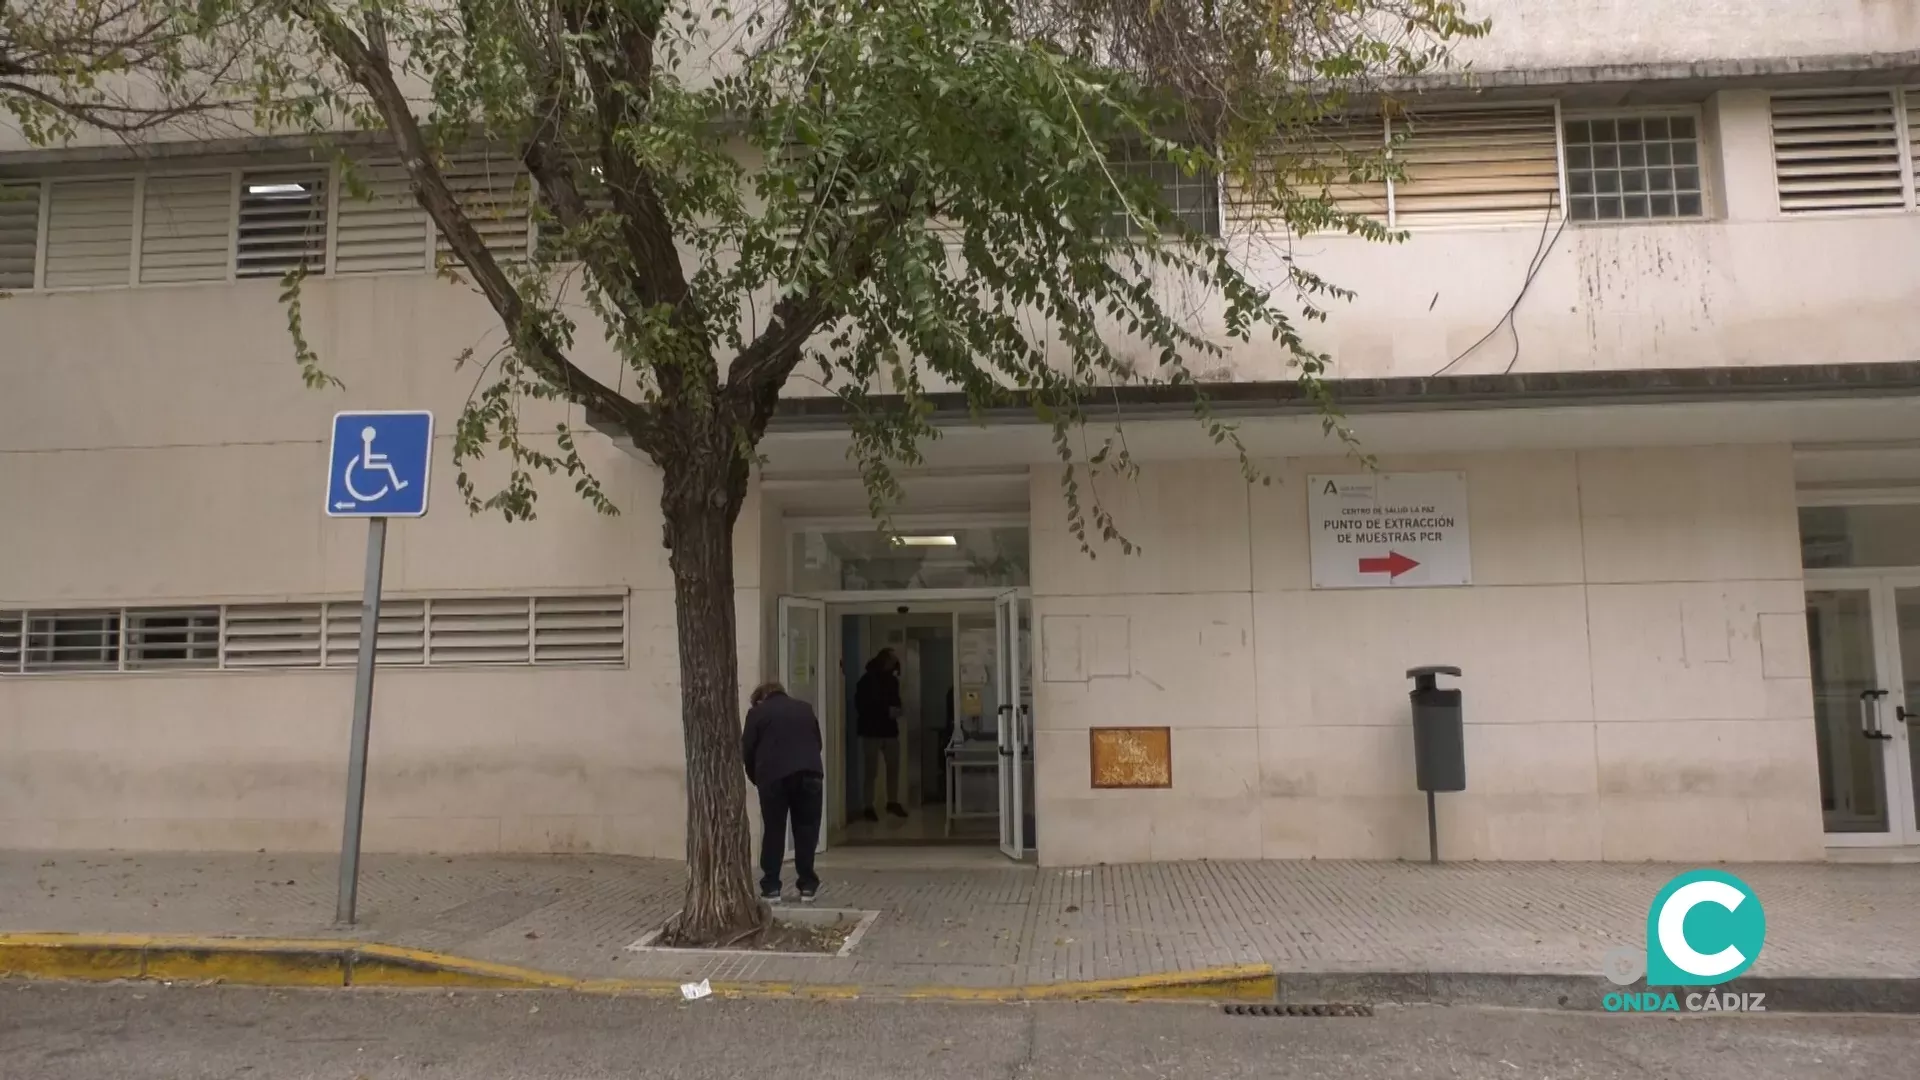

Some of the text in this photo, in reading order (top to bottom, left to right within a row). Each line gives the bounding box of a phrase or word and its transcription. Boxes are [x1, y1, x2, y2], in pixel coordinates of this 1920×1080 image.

[1324, 515, 1454, 530] PUNTO DE EXTRACCIÓN
[1337, 532, 1442, 543] DE MUESTRAS PCR
